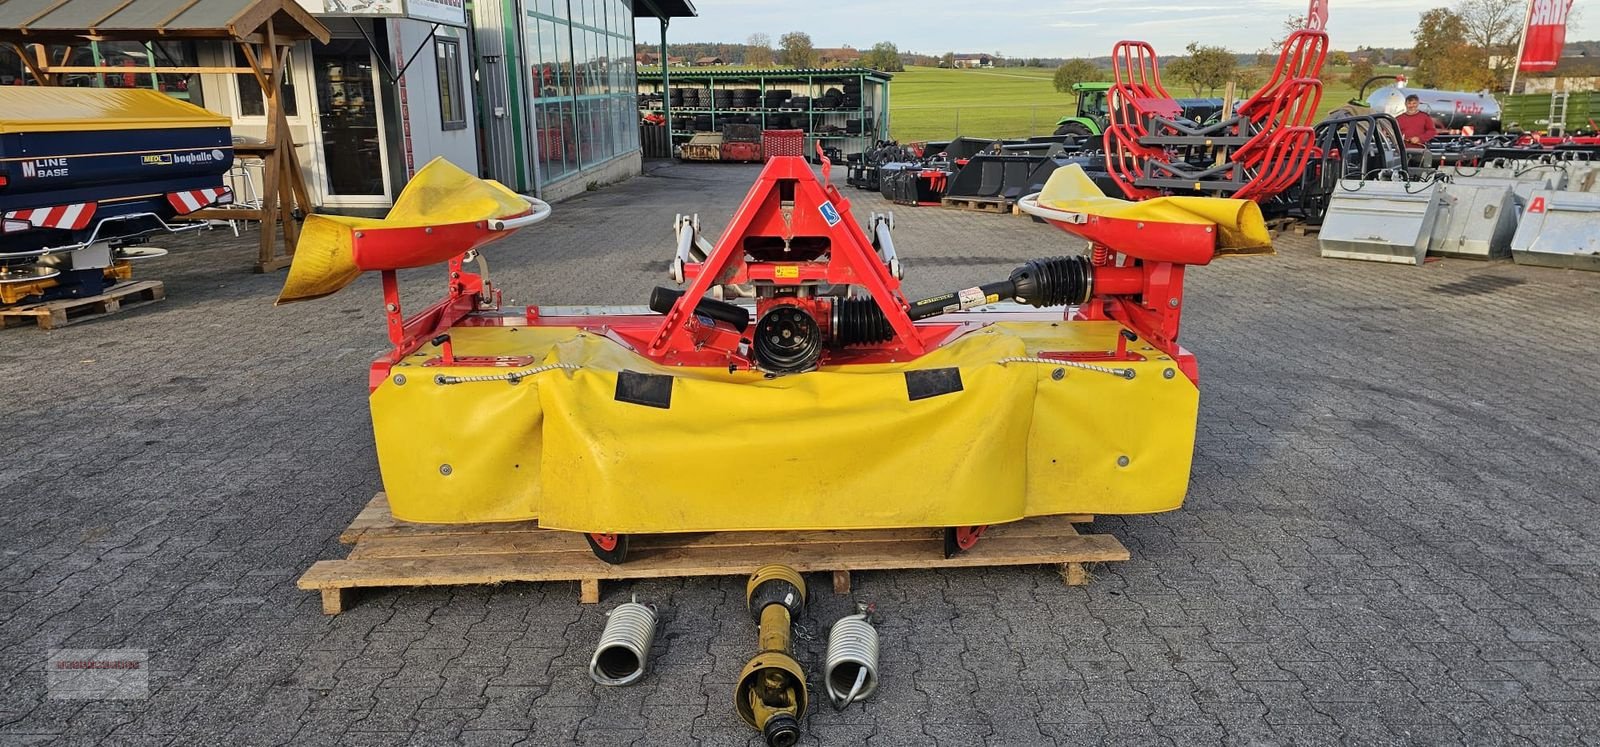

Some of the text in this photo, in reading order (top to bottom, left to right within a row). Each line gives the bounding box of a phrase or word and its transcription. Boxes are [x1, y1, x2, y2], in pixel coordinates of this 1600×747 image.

[1456, 100, 1484, 114] Fuchs
[22, 158, 68, 178] M LINE
[37, 168, 69, 178] BASE
